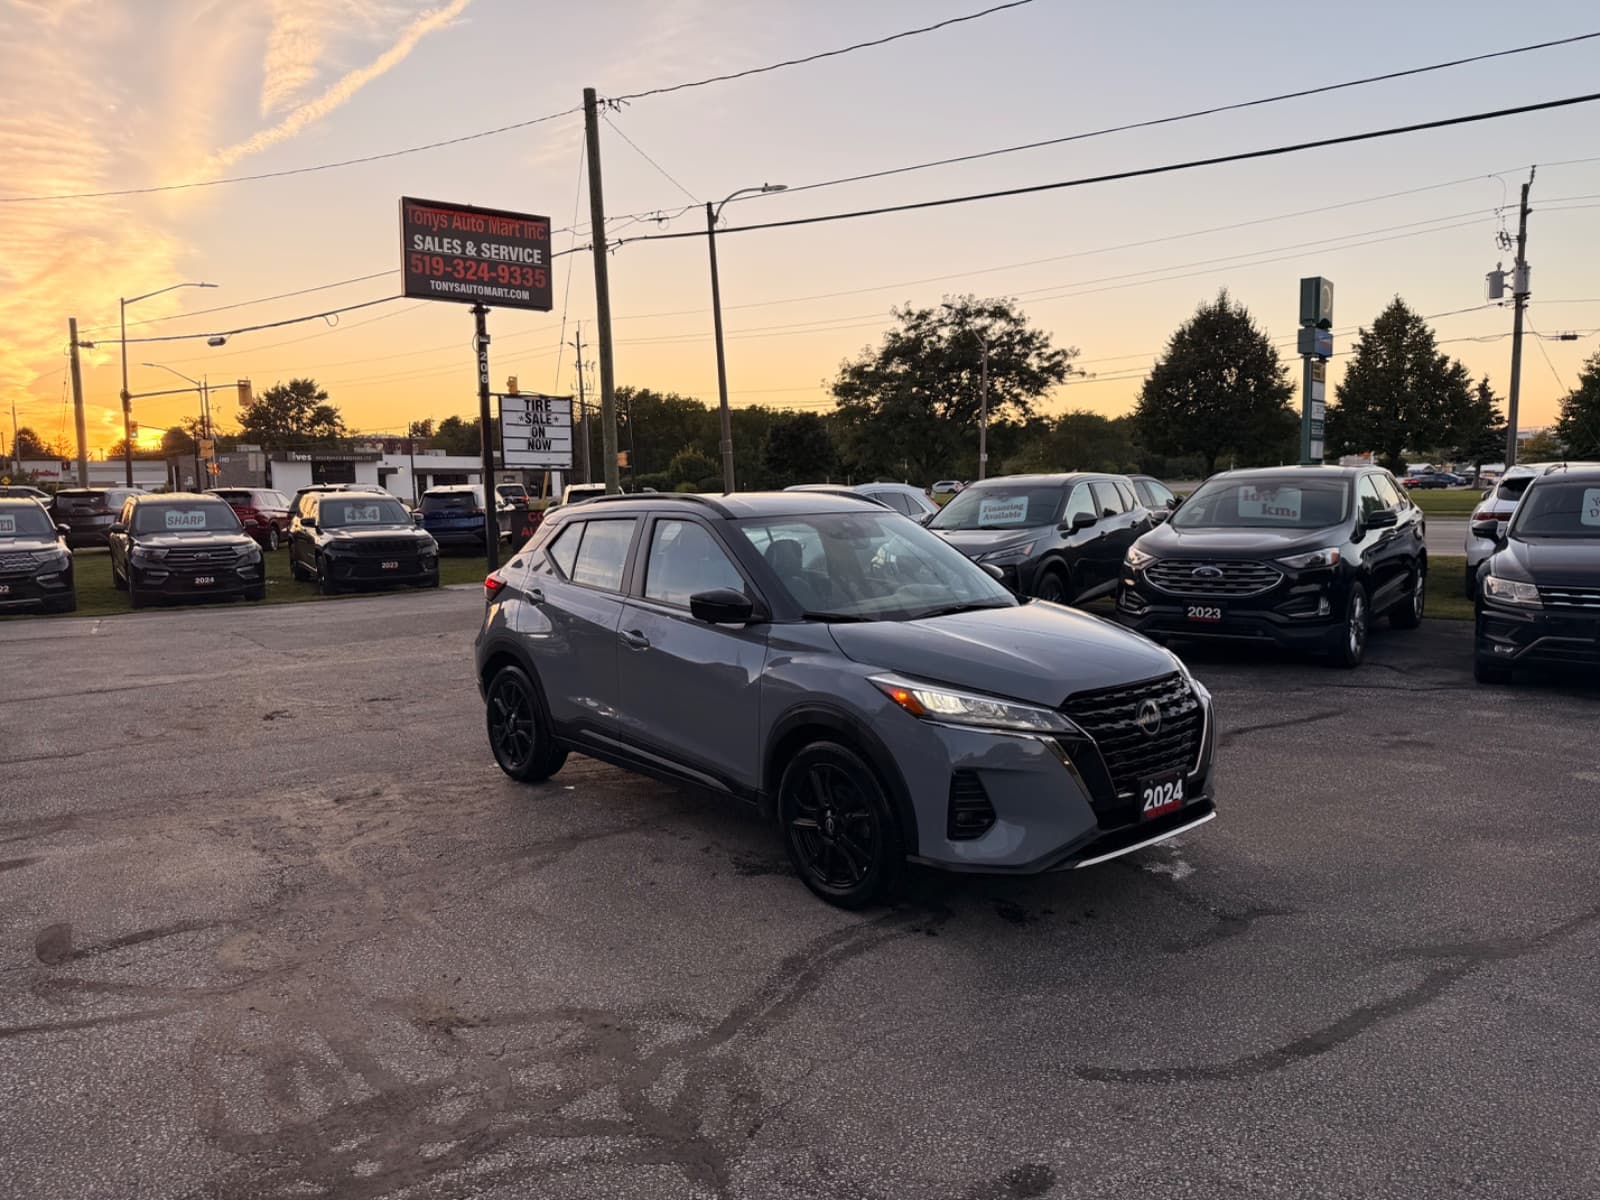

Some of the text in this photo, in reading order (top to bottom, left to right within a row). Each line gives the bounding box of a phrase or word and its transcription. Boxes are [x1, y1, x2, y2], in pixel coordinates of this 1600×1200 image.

[408, 207, 448, 232] Tonys
[452, 213, 485, 233] Auto
[489, 218, 520, 238] Mart
[413, 234, 542, 264] SALES & SERVICE
[410, 254, 546, 288] 519-324-9335
[430, 280, 530, 300] TONYSAUTOMART.COM
[524, 399, 552, 412] TIRE
[525, 412, 552, 425] SALE
[531, 426, 545, 438] ON
[527, 439, 552, 450] NOW
[983, 503, 1024, 513] Financing
[167, 514, 205, 526] SHARP
[983, 511, 1022, 521] Available
[1187, 606, 1221, 619] 2023
[1144, 779, 1183, 811] 2024
